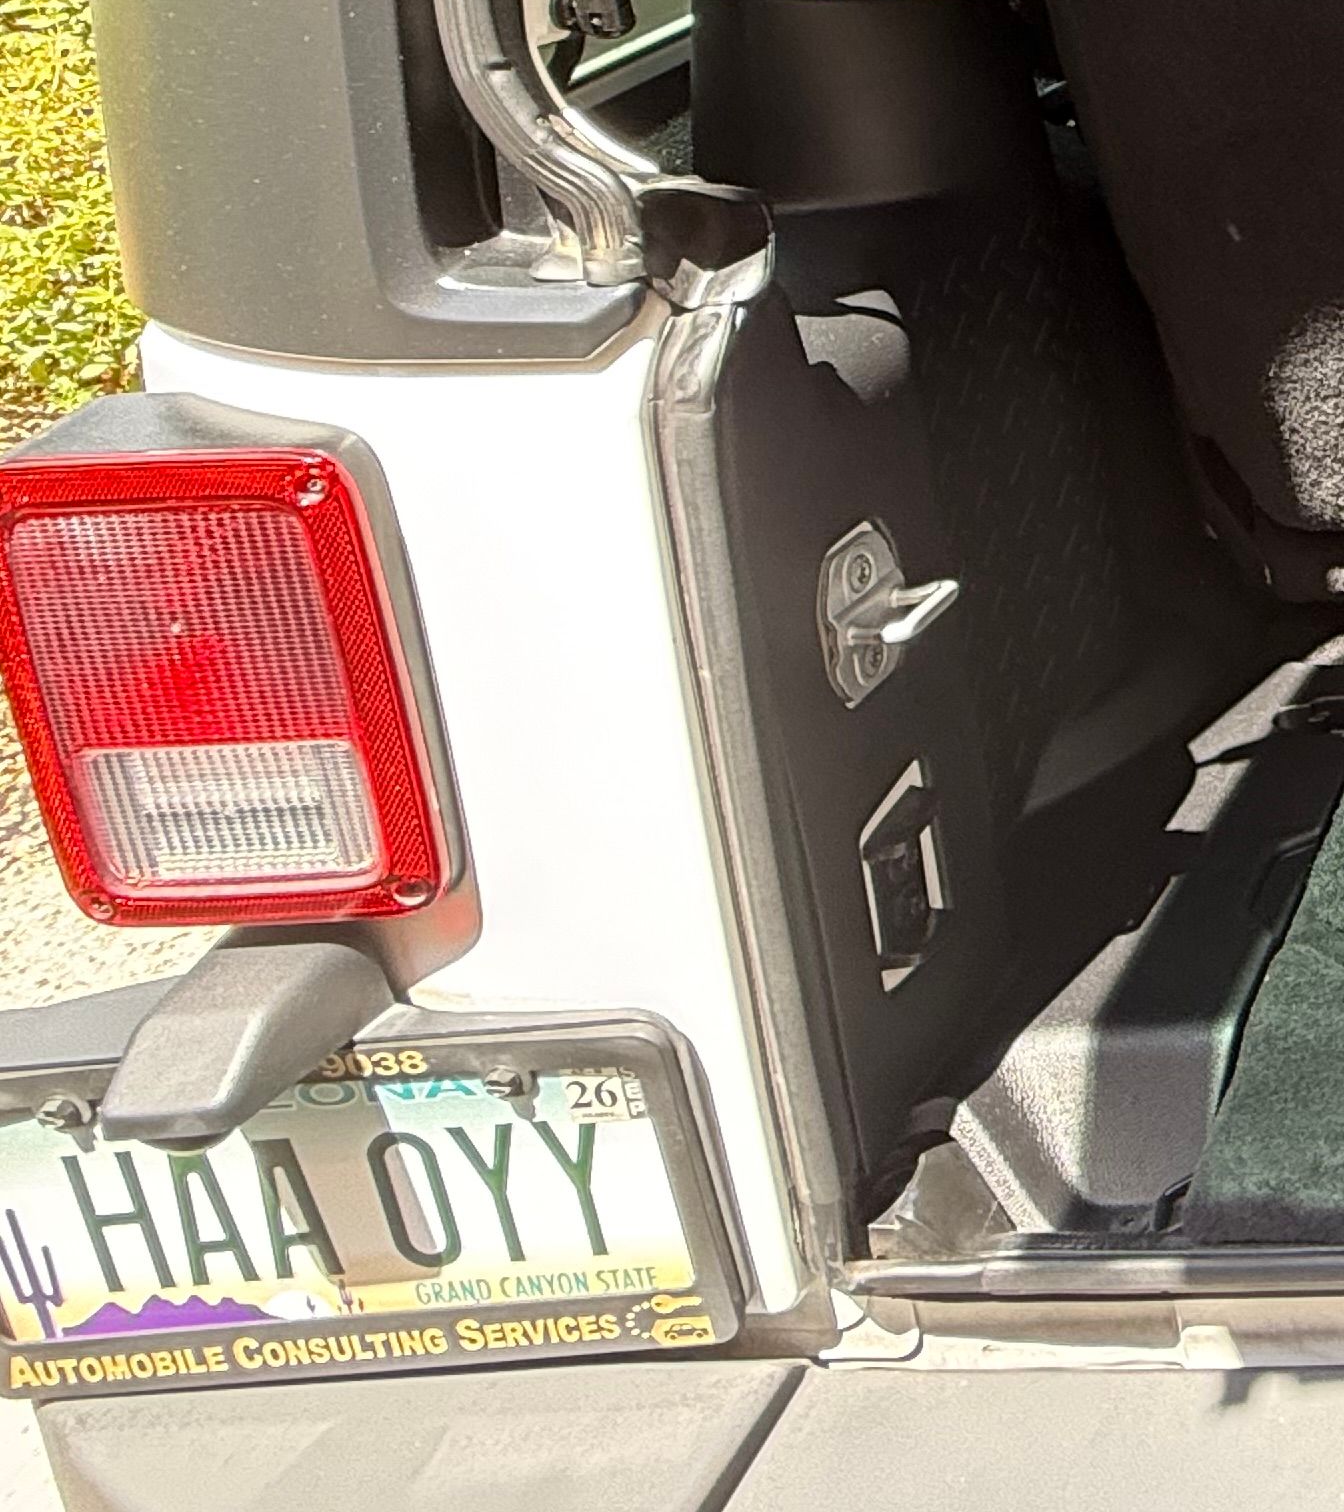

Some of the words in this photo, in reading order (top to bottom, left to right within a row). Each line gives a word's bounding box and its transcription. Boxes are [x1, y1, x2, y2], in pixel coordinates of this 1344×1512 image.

[318, 1050, 428, 1078] 9038
[566, 1076, 618, 1109] 26
[61, 1138, 345, 1292] HAA
[416, 1277, 492, 1306] GRAND
[500, 1271, 588, 1299] CANYON
[596, 1266, 658, 1291] STATE
[10, 1345, 230, 1389] AUTOMOBILE
[232, 1327, 449, 1370] CONSULTING
[455, 1314, 621, 1352] SERVICES
